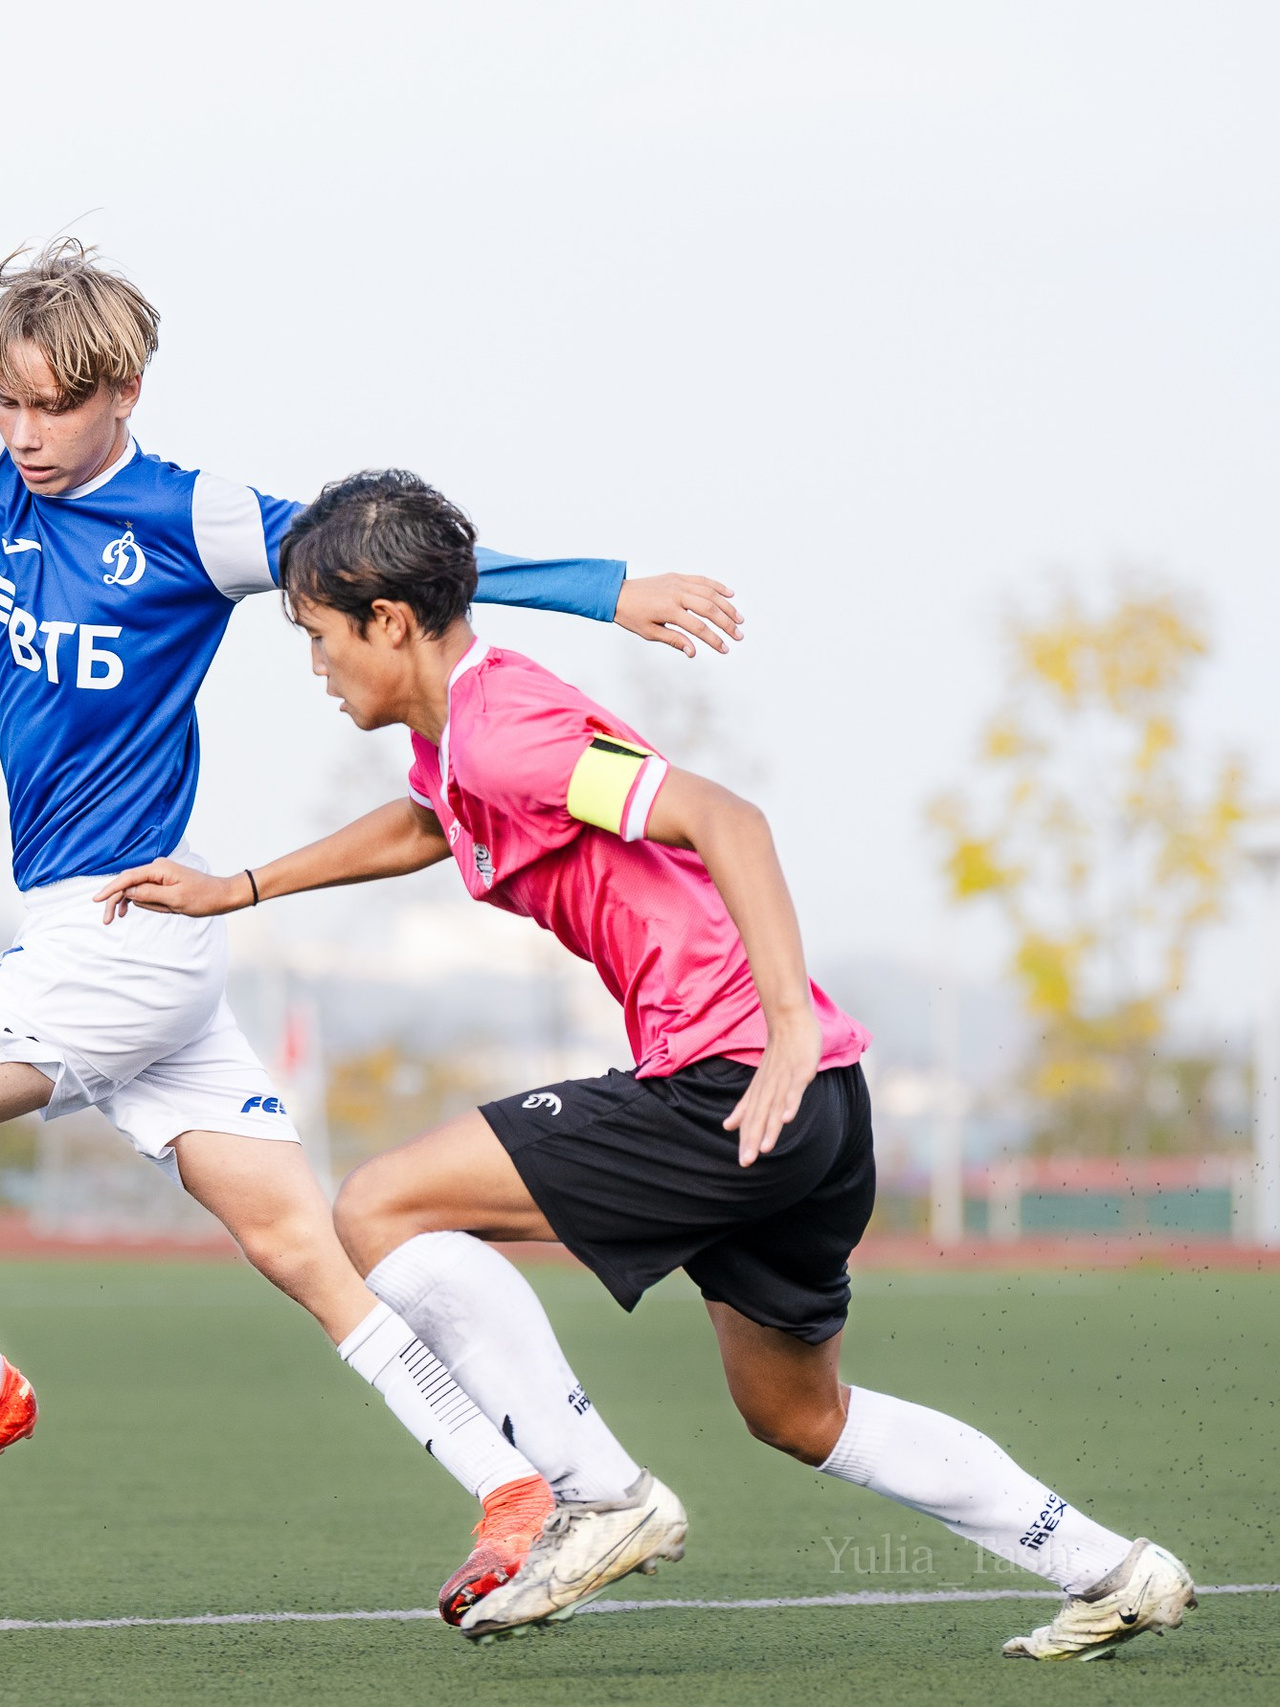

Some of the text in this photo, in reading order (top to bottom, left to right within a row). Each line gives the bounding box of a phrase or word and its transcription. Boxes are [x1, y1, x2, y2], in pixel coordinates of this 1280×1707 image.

[8, 606, 124, 690] ВТБ
[1019, 1493, 1057, 1546] ALTAIC
[1027, 1500, 1068, 1551] IBEX
